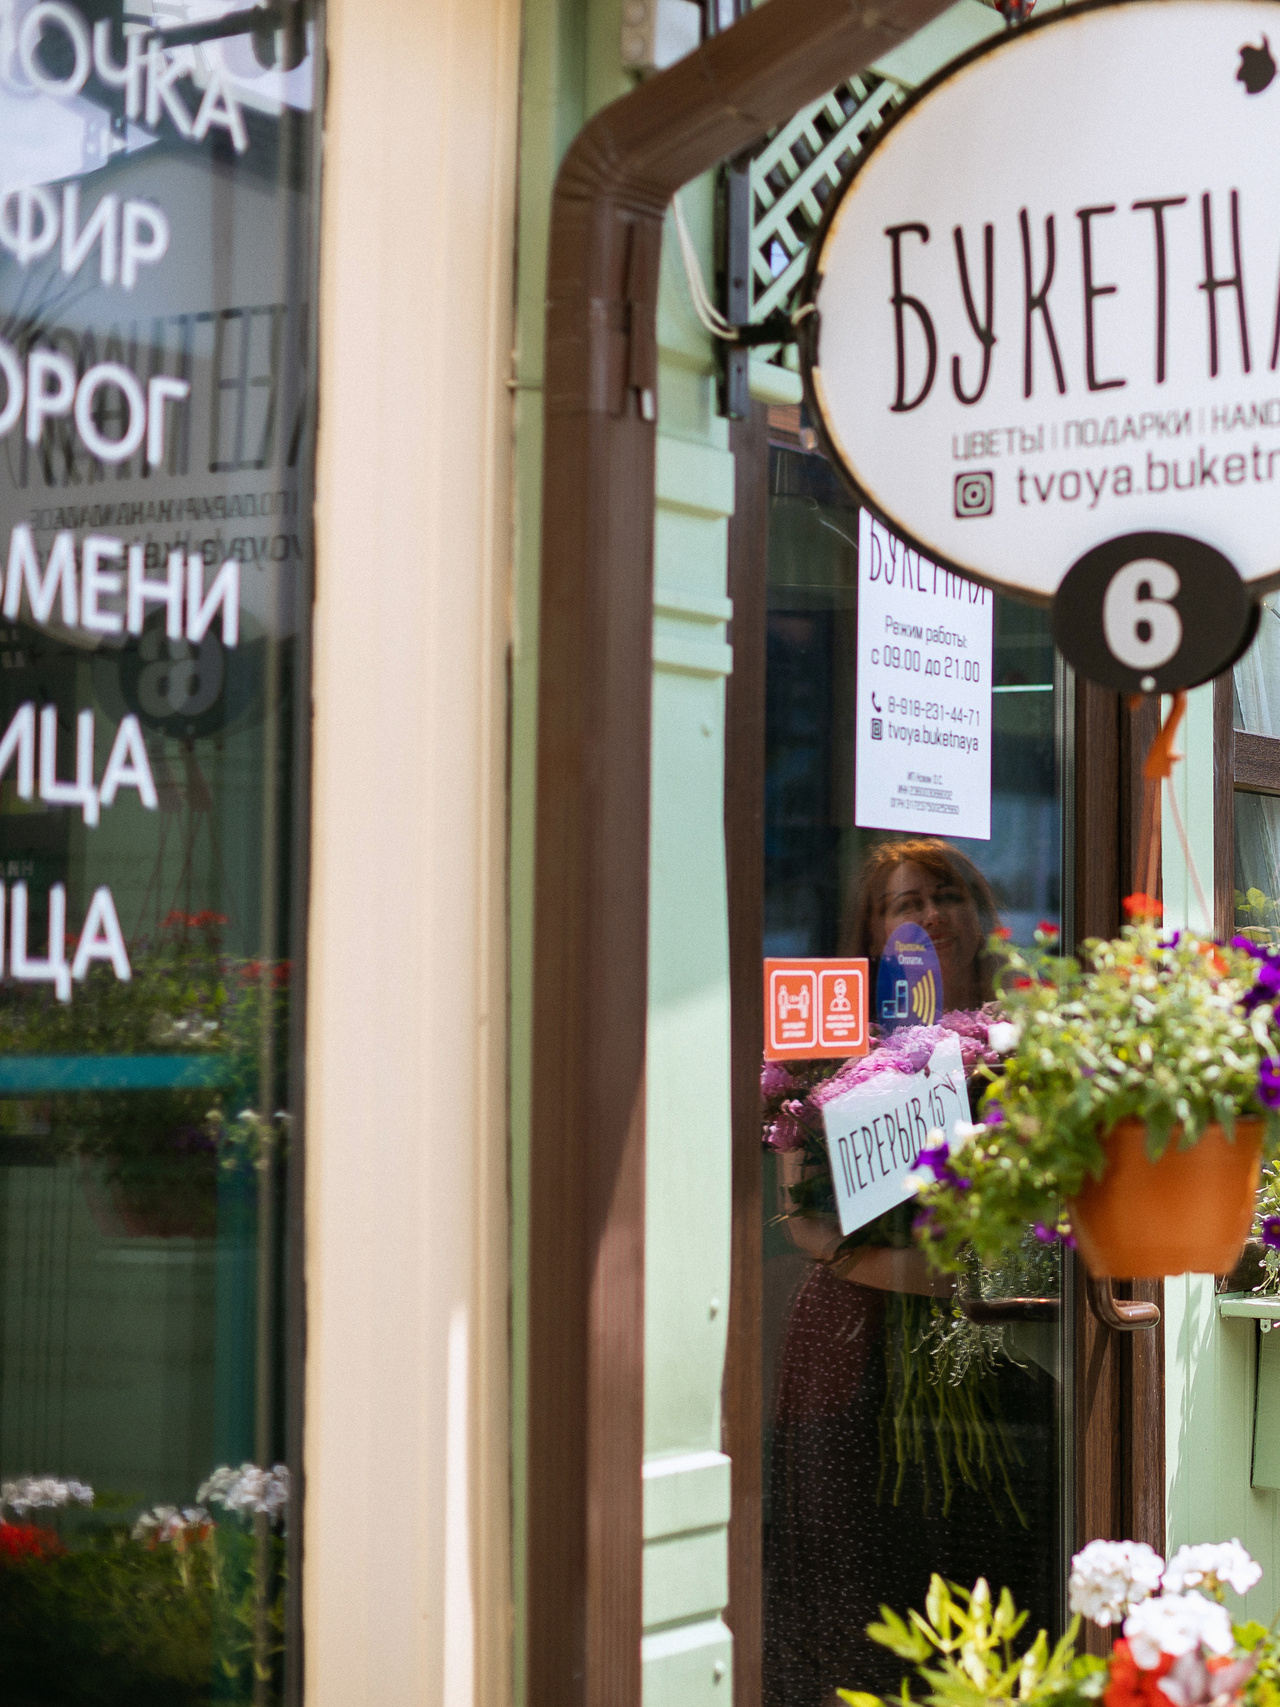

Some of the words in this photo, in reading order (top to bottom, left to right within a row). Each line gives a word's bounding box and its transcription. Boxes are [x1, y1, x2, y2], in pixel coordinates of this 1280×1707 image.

[952, 424, 1045, 461] ЦВЕТЫ
[1064, 409, 1191, 449] ПОДАРКИ
[0, 522, 241, 648] МЕНИ
[885, 615, 923, 639] Режим
[926, 626, 967, 648] работы:
[1101, 558, 1182, 669] 6
[871, 648, 880, 665] с
[883, 645, 920, 672] 09.00
[925, 658, 941, 676] до
[944, 656, 980, 683] 21.00
[888, 696, 980, 726] 8-918-231-44-71
[888, 721, 979, 754] tvoya.buketnaya
[0, 880, 131, 1003] ЦА
[838, 1097, 928, 1197] ПЕРЕРЫВ
[928, 1083, 946, 1128] 15
